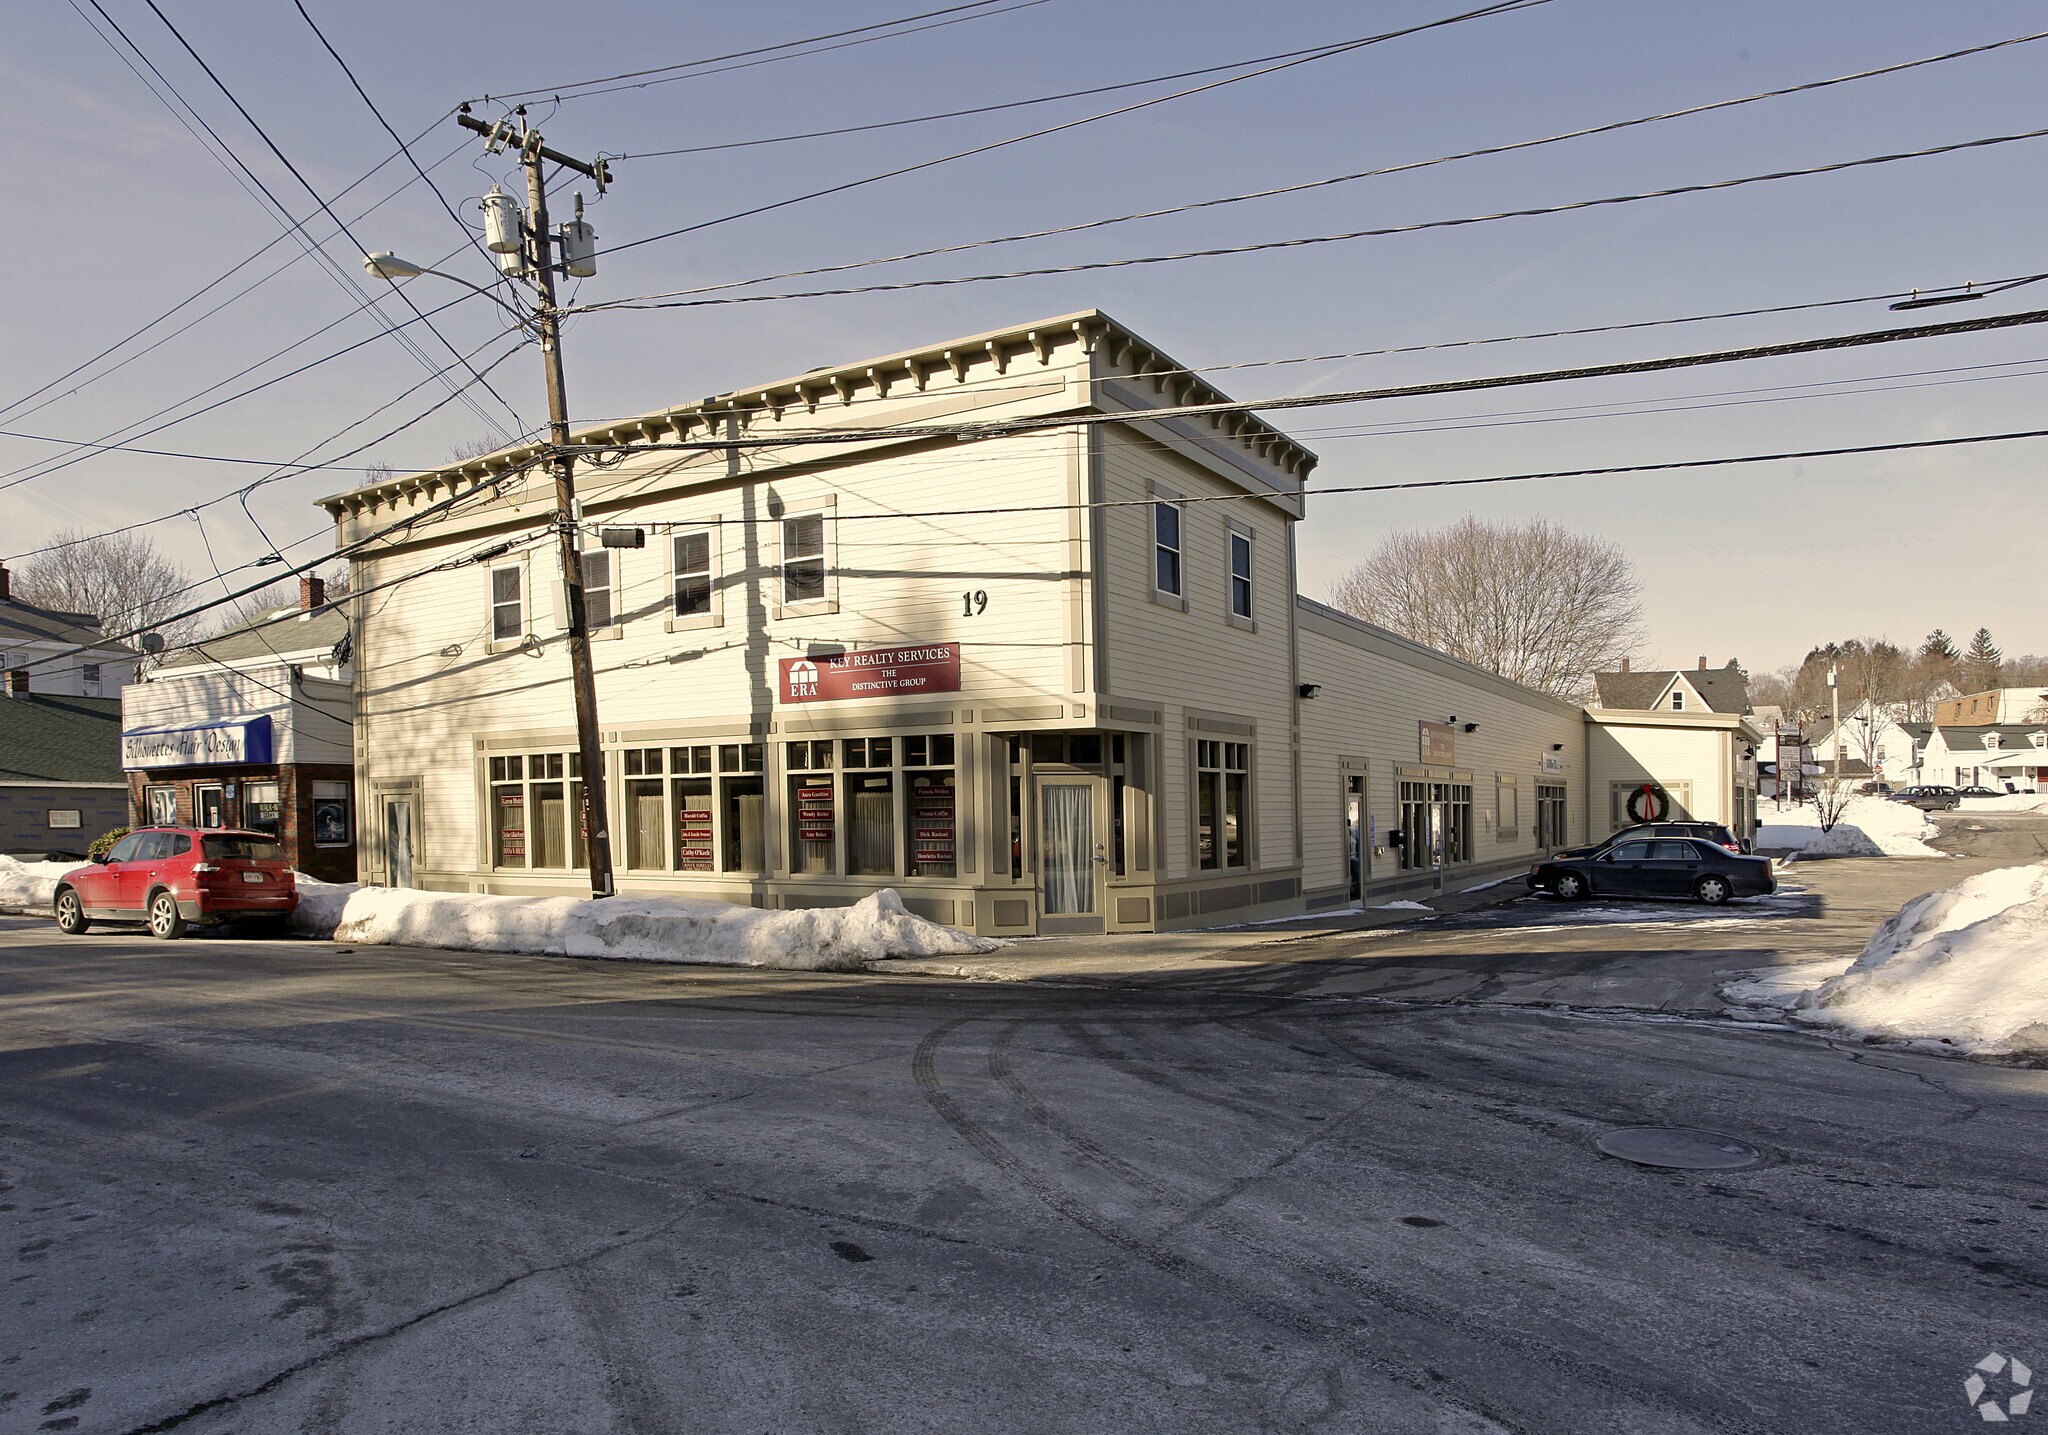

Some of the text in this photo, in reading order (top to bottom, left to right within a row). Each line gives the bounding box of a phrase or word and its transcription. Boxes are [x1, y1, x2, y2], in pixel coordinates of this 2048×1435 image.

[962, 589, 988, 617] 19
[829, 647, 950, 669] KEY REALTY SERVICES
[881, 669, 897, 678] THE
[791, 683, 816, 697] ERA
[852, 678, 926, 691] DISTINCTIVE GROUP
[126, 731, 241, 761] Silhouettes Hair Design
